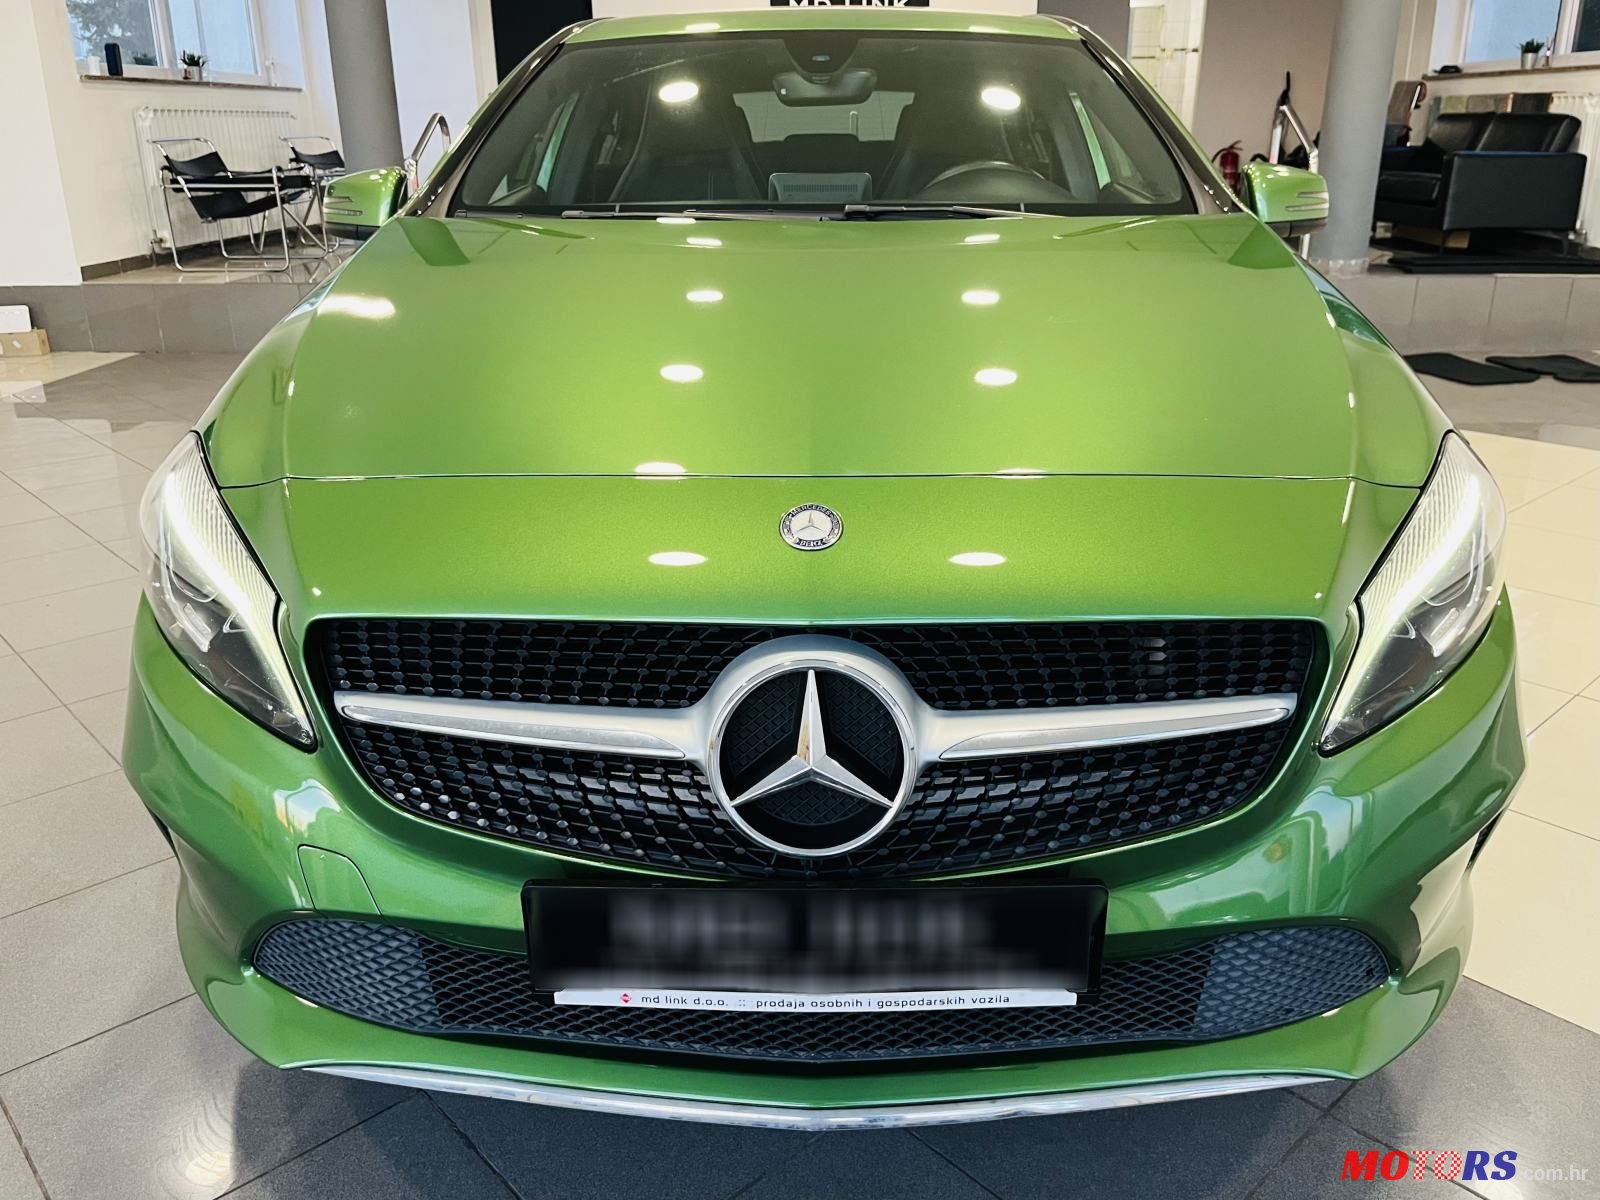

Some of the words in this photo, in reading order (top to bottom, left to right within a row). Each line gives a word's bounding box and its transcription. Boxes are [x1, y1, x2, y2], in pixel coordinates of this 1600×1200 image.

[641, 994, 660, 1004] md
[665, 995, 688, 1005] link
[693, 996, 729, 1006] d.o.o.
[756, 999, 805, 1009] prodaja
[810, 999, 863, 1008] osobnih
[877, 996, 965, 1009] gospodarskih
[971, 994, 1010, 1004] vozila
